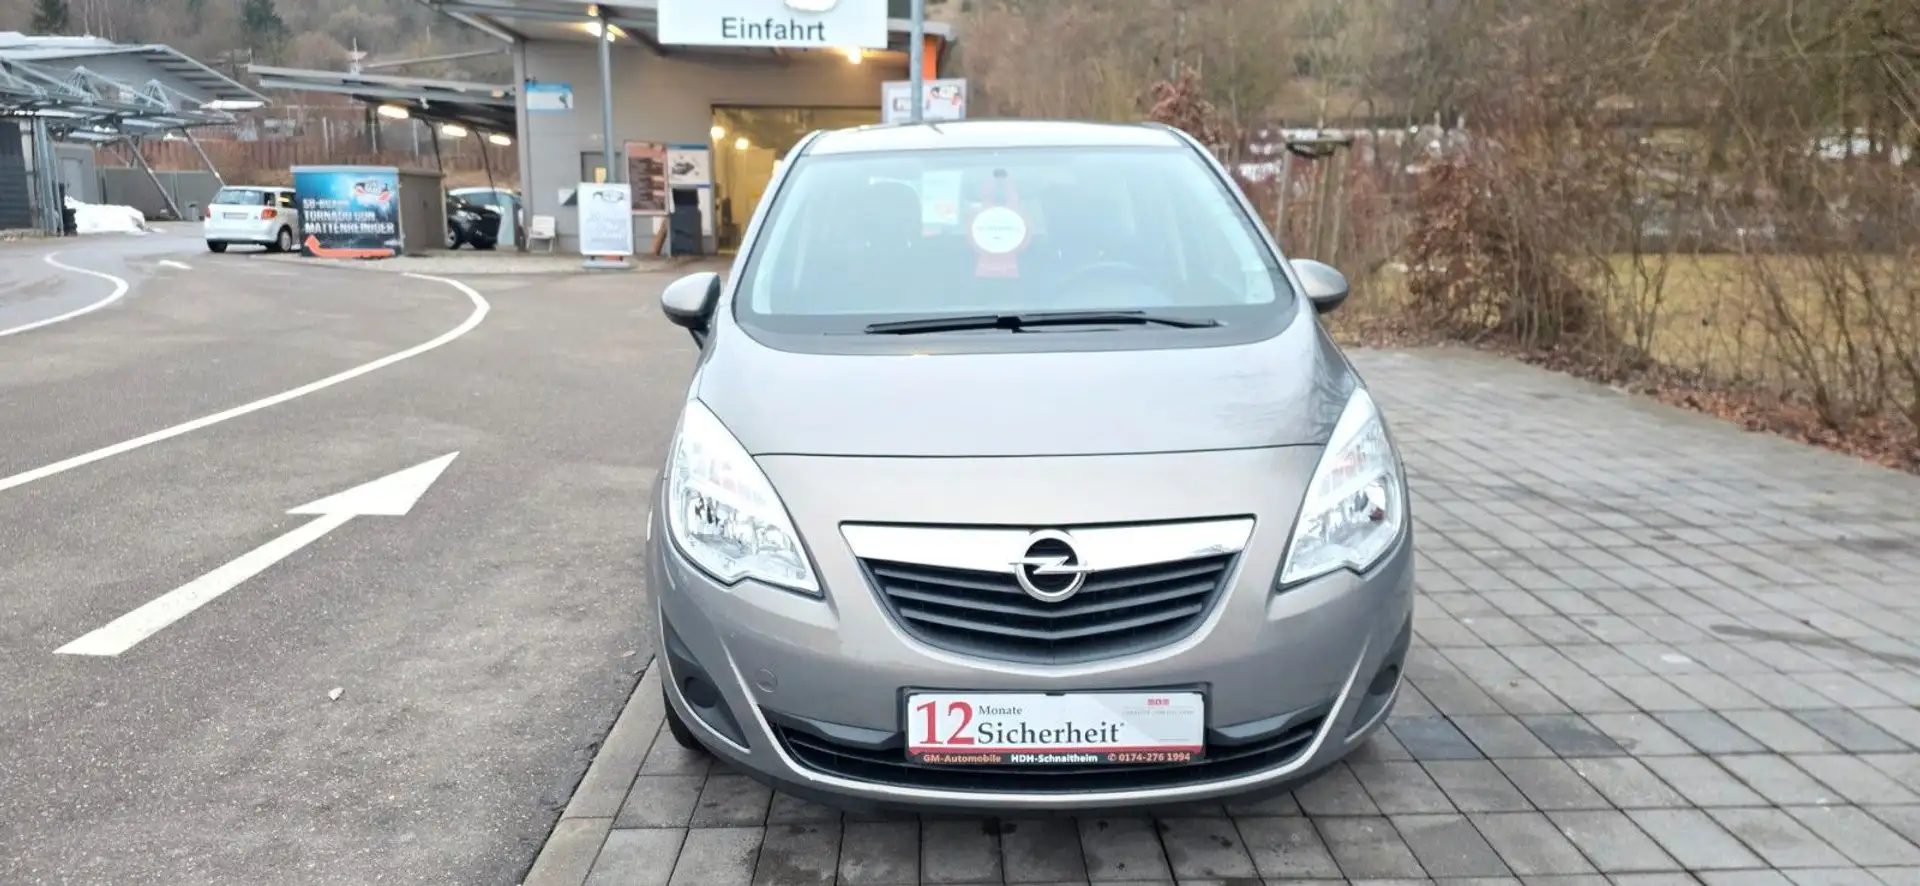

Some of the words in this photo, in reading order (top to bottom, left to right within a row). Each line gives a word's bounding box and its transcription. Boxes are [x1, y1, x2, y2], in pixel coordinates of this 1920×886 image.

[721, 16, 826, 41] Einfahrt
[978, 705, 1023, 715] Monate
[916, 700, 975, 745] 12
[923, 753, 1001, 764] GM-Automobile
[1010, 753, 1098, 763] HDH-Schnaitheim
[1118, 752, 1165, 762] 0174-276
[1167, 751, 1191, 761] 1994
